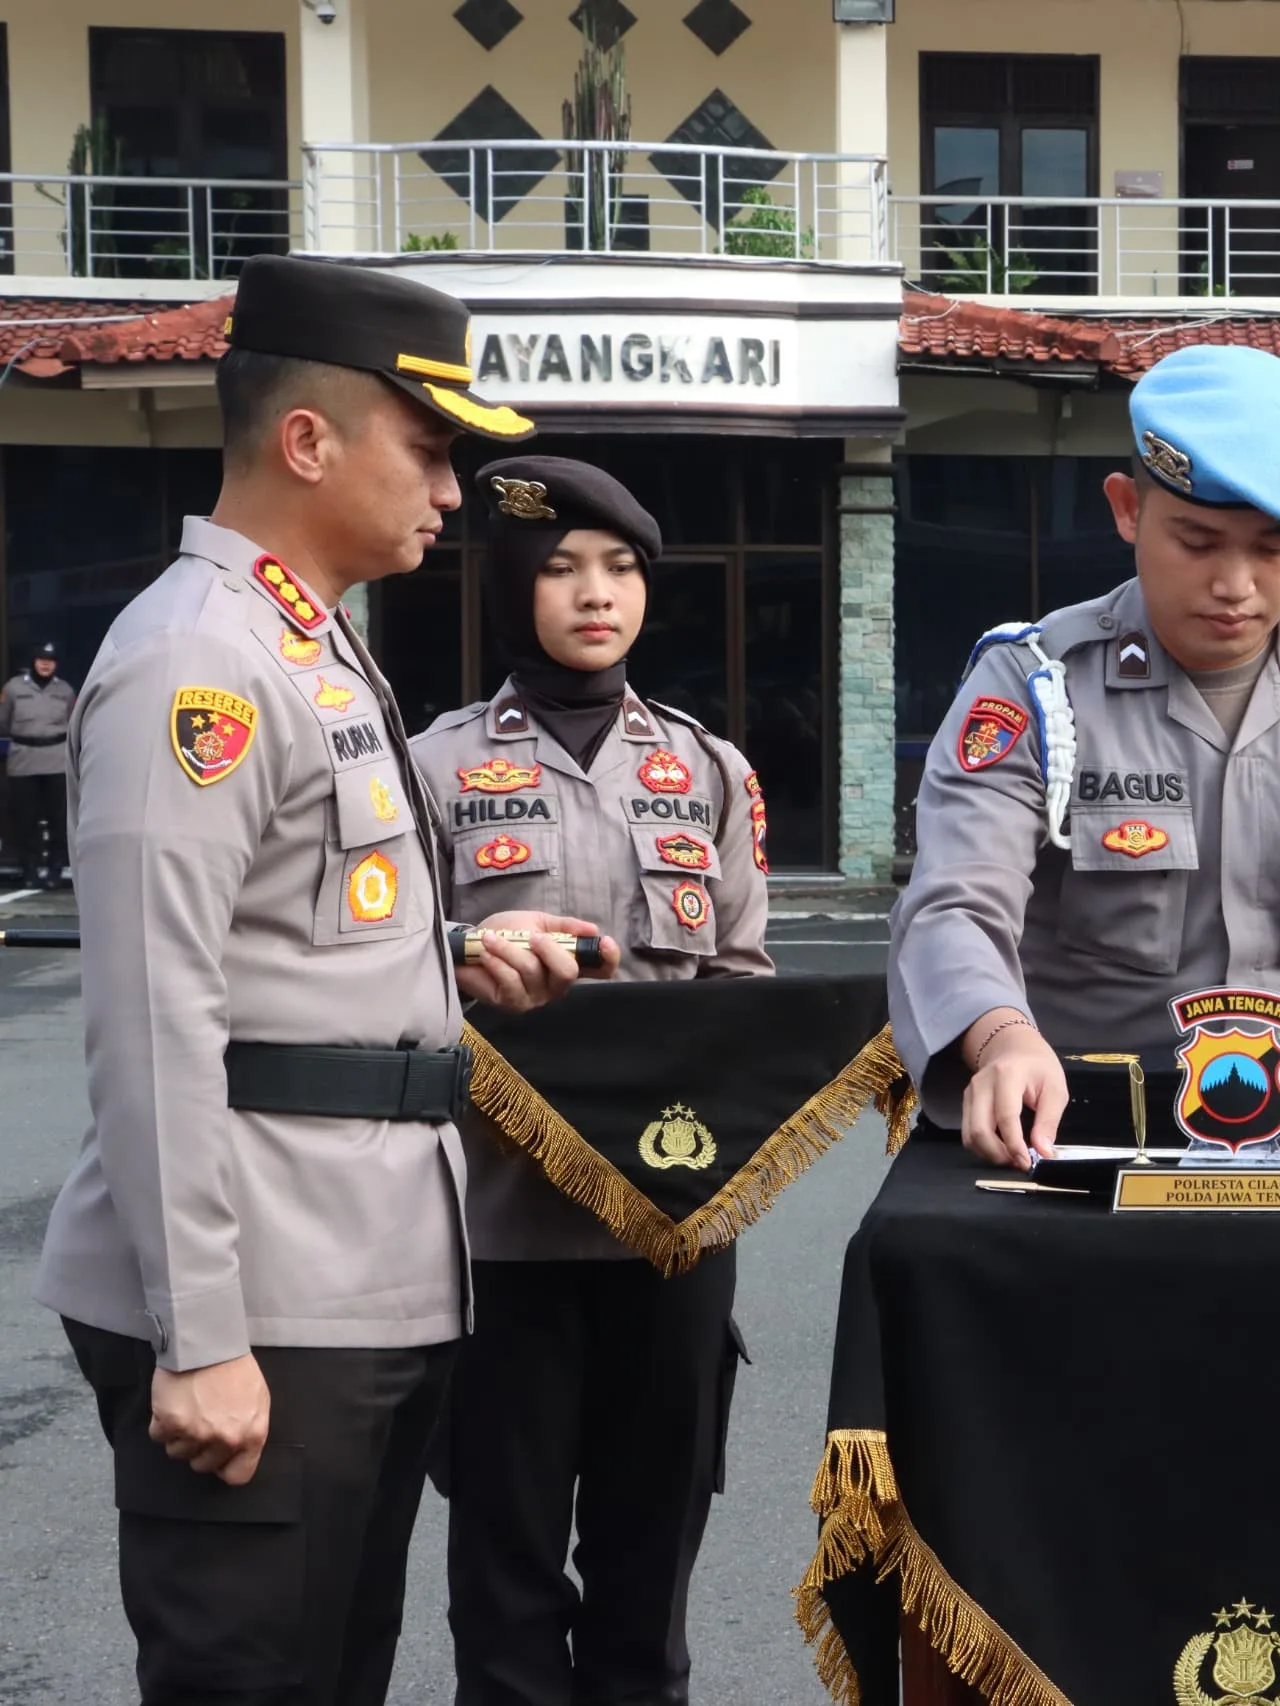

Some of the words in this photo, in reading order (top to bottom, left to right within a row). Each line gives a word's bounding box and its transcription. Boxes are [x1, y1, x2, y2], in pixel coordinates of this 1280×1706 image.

[478, 333, 781, 386] AYANGKARI
[180, 690, 253, 724] RESERSE
[979, 701, 1024, 724] PROPAM
[1078, 771, 1184, 802] BAGUS
[454, 797, 551, 827] HILDA
[631, 797, 711, 827] POLRI
[1186, 998, 1225, 1018] JAWA
[1165, 1192, 1212, 1203] POLDA
[1215, 1192, 1252, 1205] JAWA
[1173, 1179, 1244, 1191] POLRESTA
